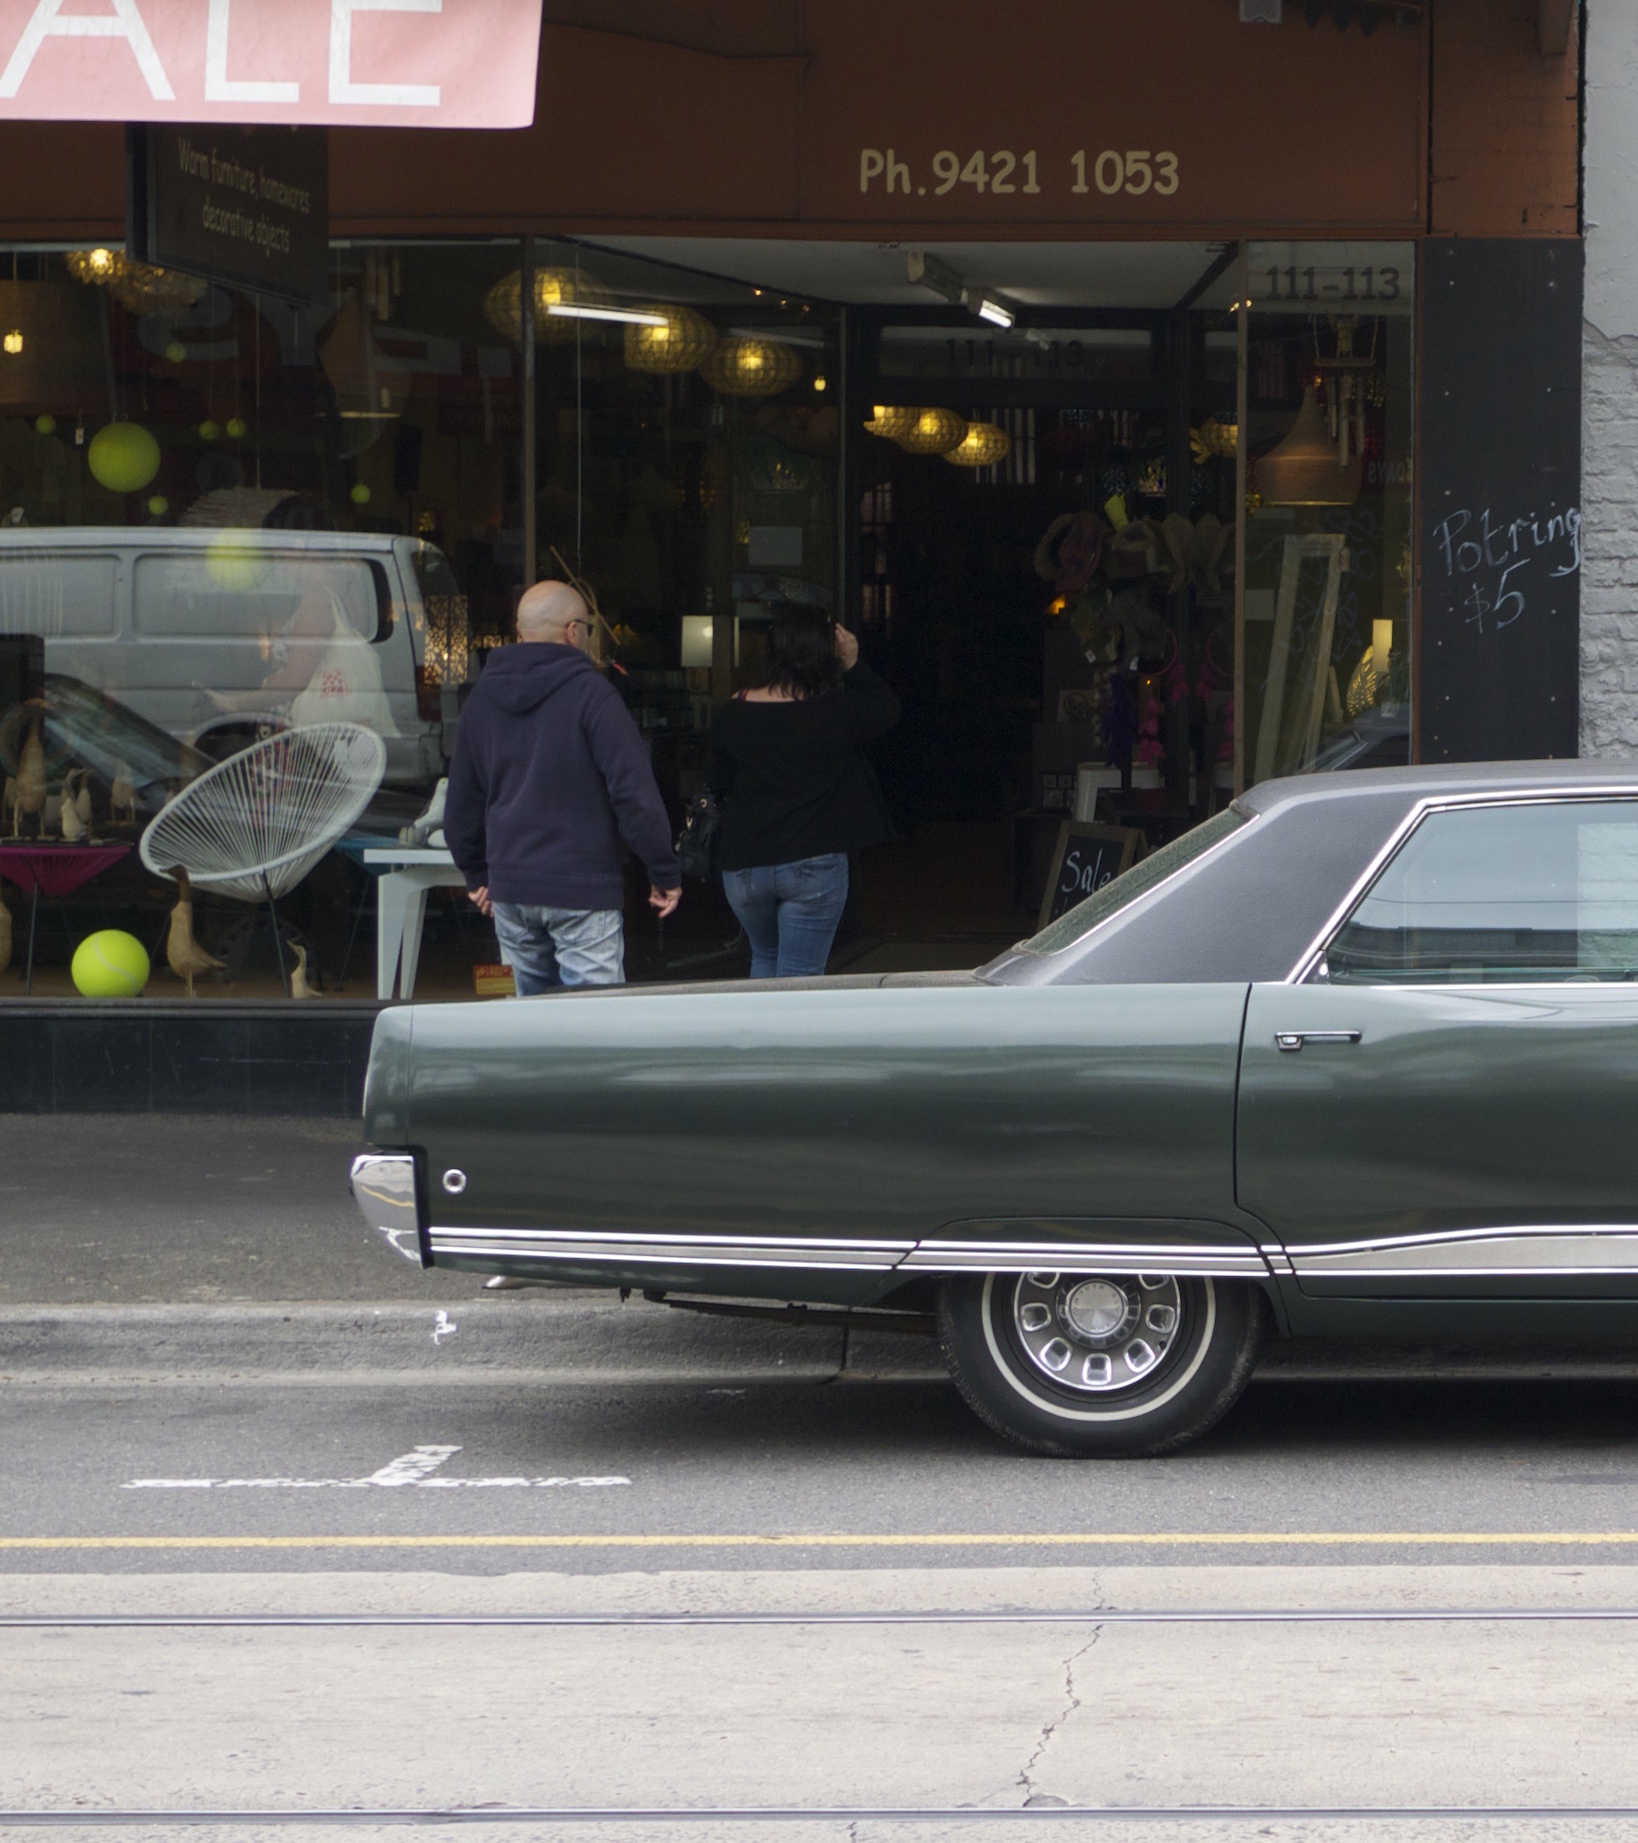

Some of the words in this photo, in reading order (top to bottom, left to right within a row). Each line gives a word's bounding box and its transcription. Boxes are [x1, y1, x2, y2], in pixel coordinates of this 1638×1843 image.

[178, 136, 210, 180] Warm
[260, 165, 310, 214] homewares
[859, 148, 1041, 197] Ph.9421
[1070, 148, 1180, 196] 1053
[203, 194, 255, 242] decorative
[256, 212, 290, 257] objects
[1265, 265, 1401, 302] 111-113
[1464, 557, 1532, 634] $5
[1060, 848, 1112, 895] Sale
